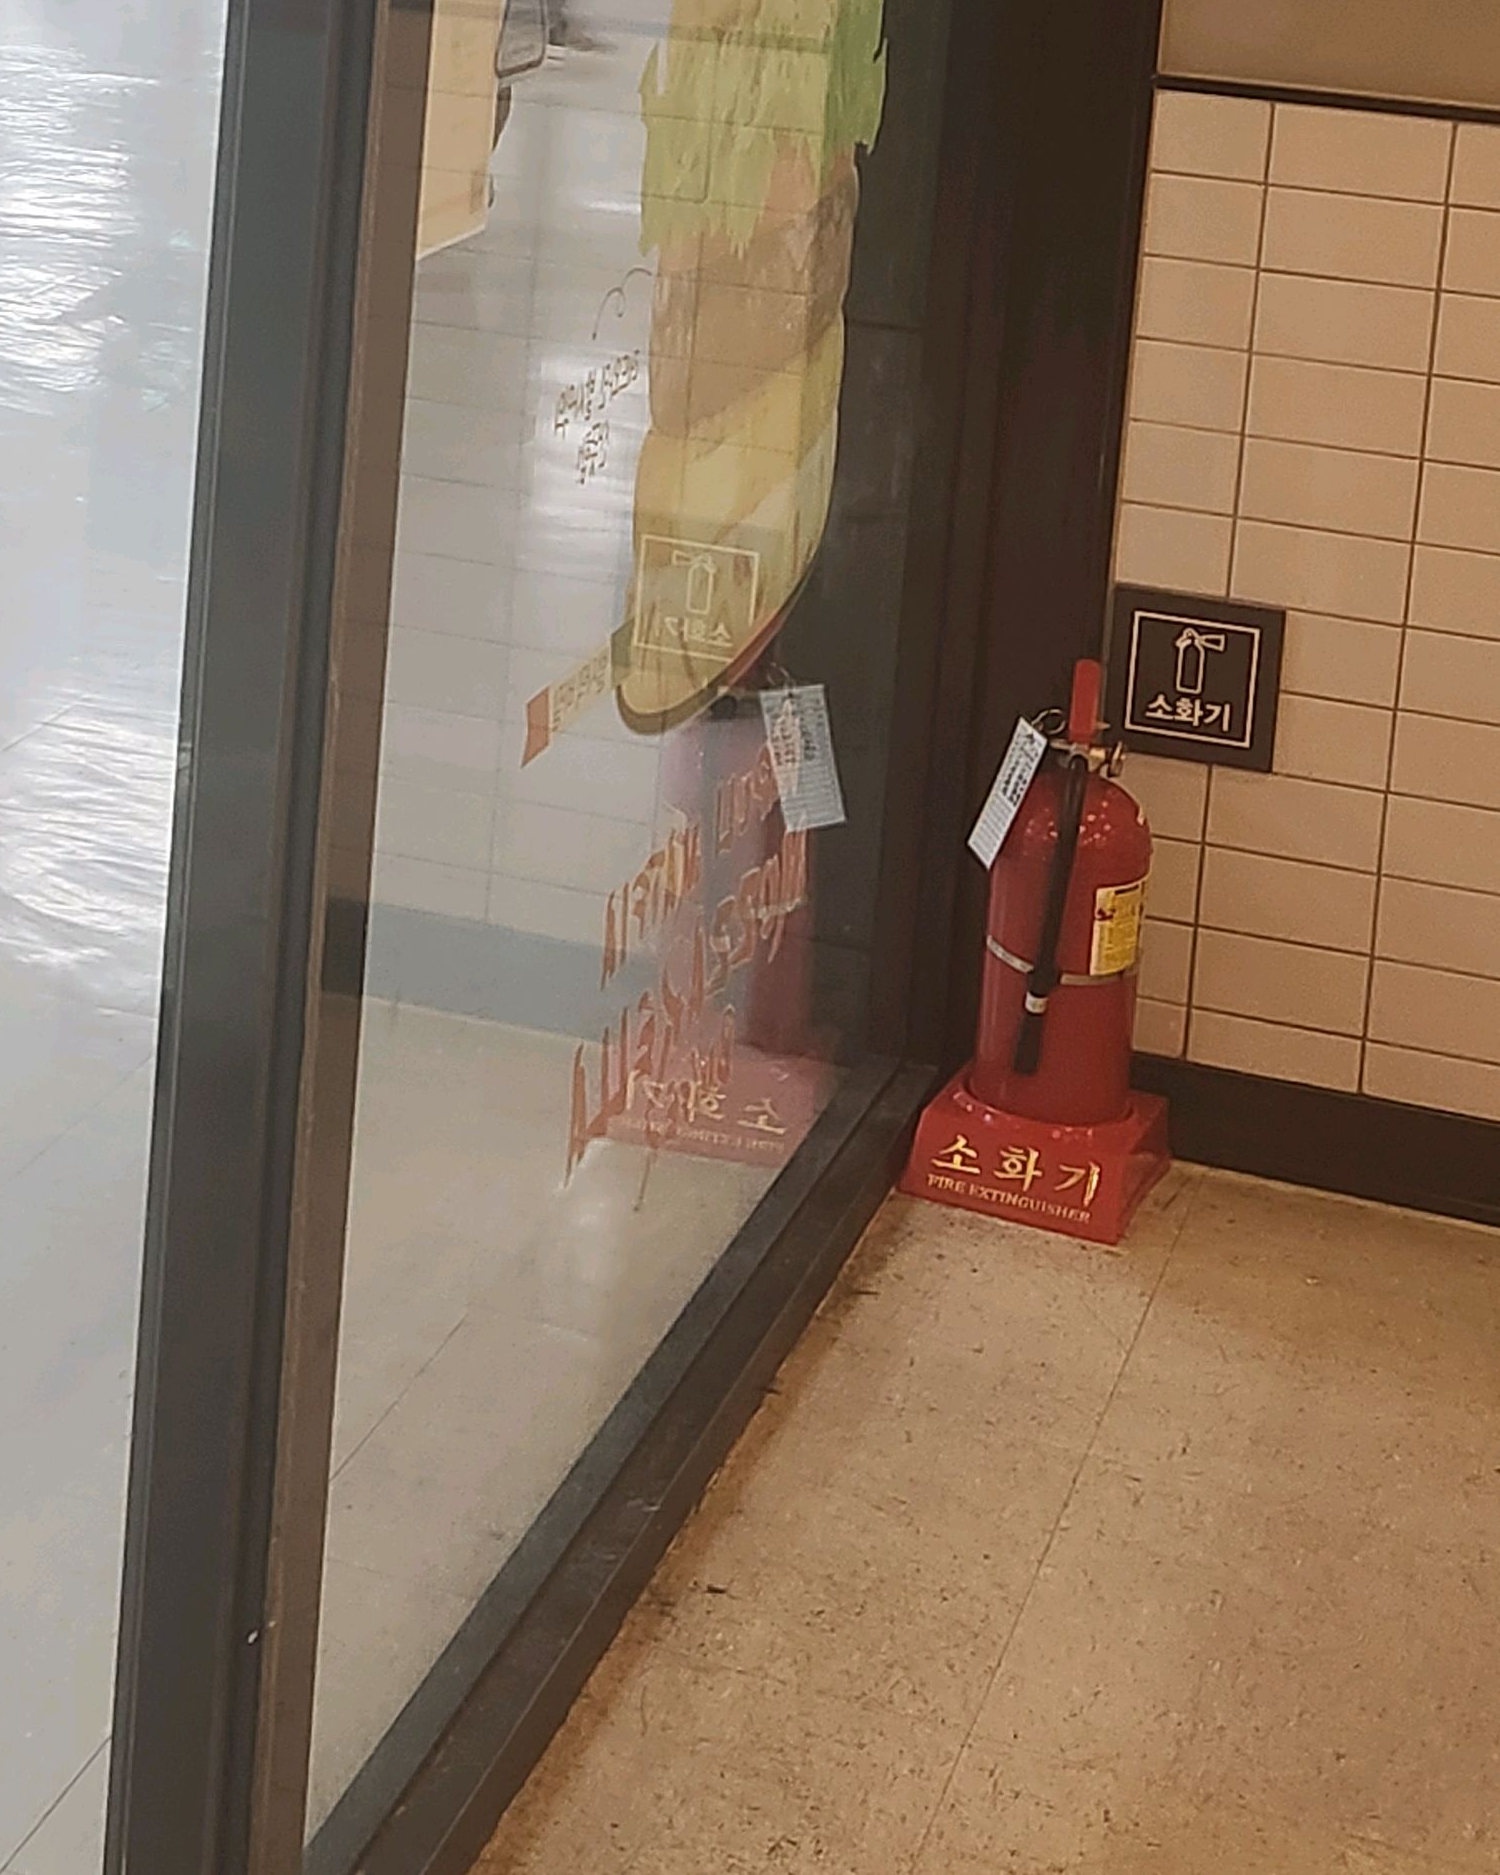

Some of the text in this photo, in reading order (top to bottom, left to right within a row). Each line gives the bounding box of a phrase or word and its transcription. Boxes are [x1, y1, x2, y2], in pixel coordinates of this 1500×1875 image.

[1145, 694, 1231, 732] 소화기
[930, 1134, 1100, 1207] 소화기
[927, 1173, 1092, 1224] FIRE EXTINGUISHER
